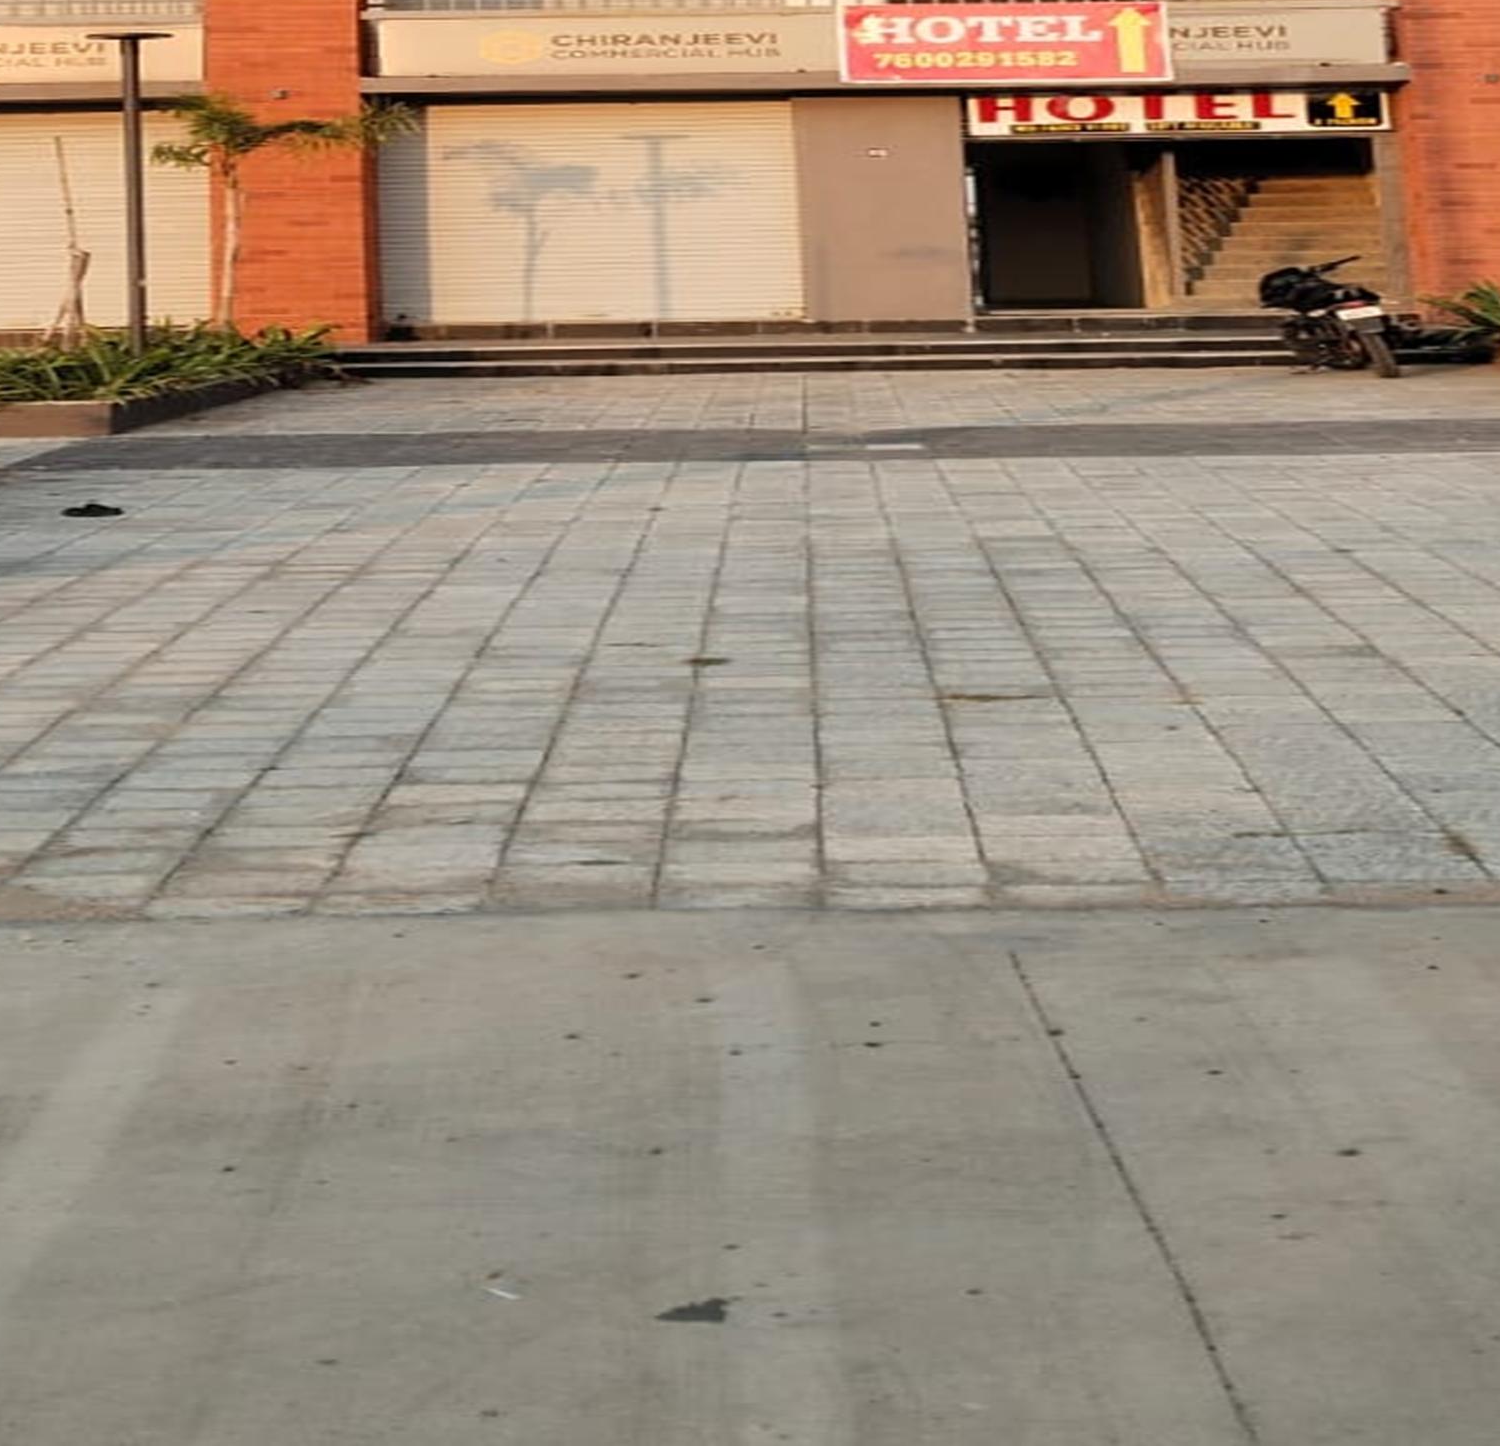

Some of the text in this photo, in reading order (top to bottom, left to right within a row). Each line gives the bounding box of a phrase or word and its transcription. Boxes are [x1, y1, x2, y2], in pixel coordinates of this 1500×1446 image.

[854, 14, 1103, 45] HOTEL
[550, 32, 778, 48] CHIRANJEEVI
[727, 47, 781, 58] HUB
